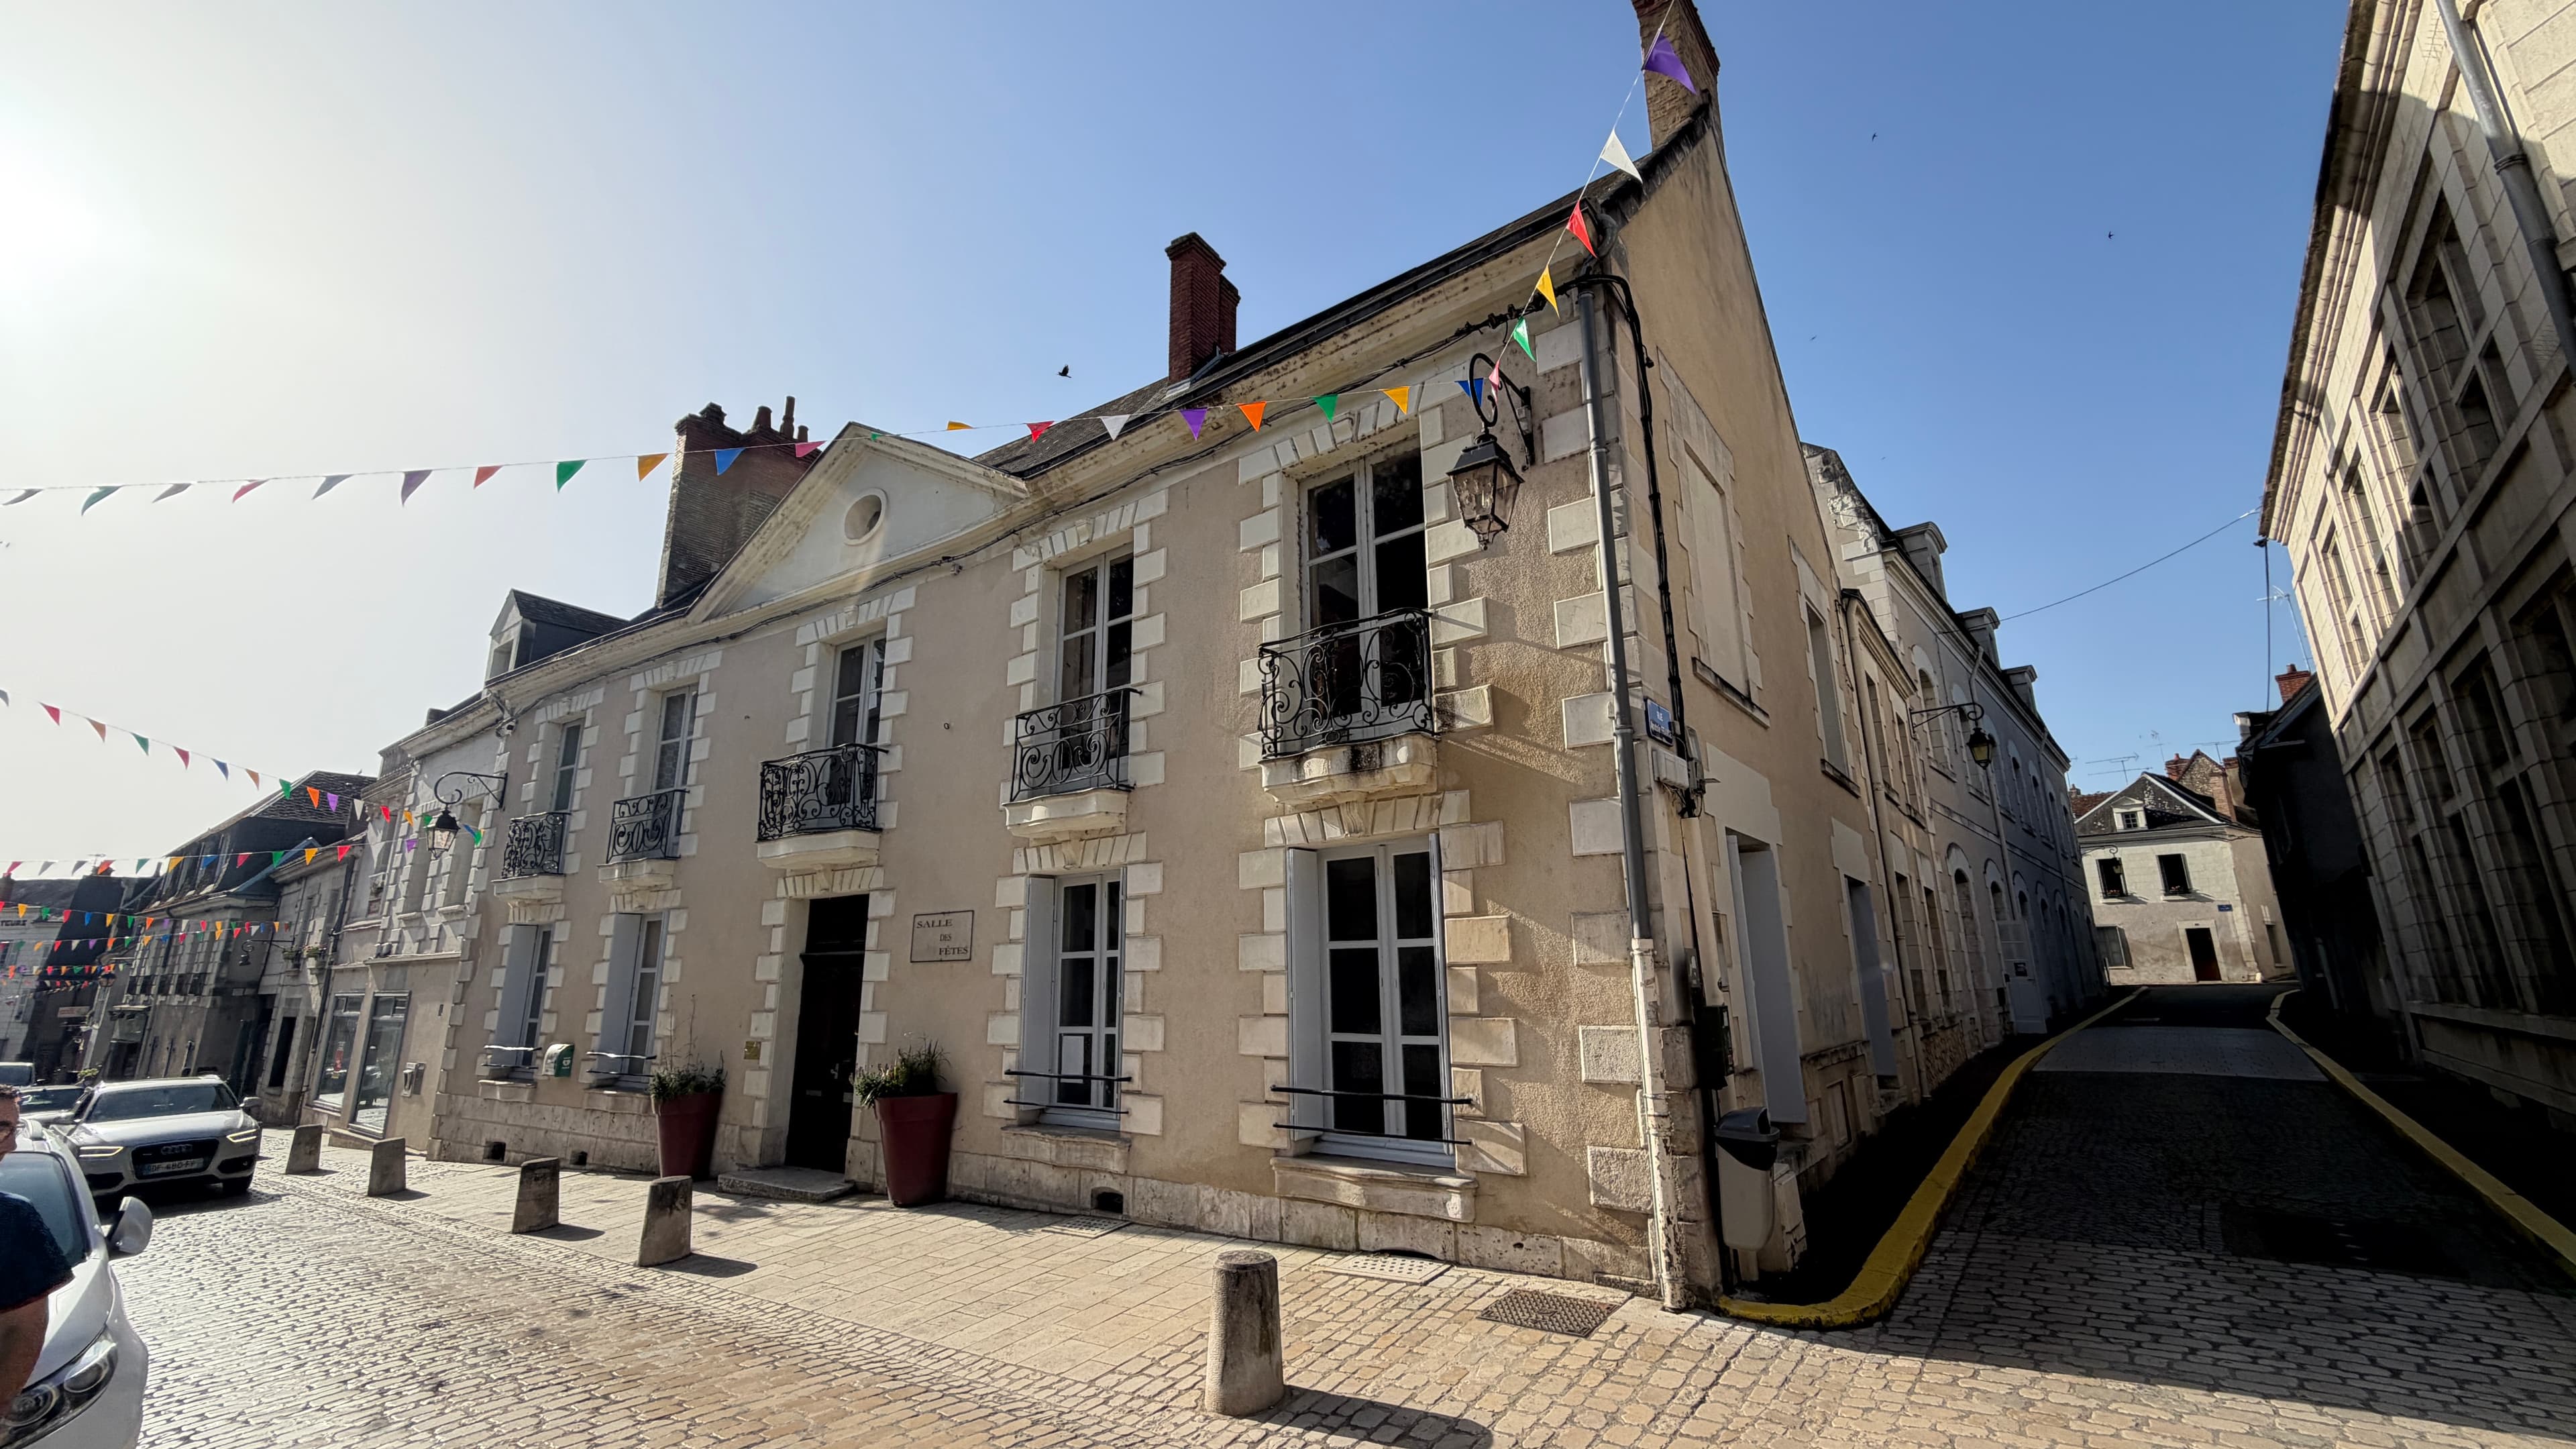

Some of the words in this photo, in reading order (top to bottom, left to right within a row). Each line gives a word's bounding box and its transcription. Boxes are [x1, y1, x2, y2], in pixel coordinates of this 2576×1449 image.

[916, 919, 953, 928] SALLE
[940, 933, 951, 941] DES
[939, 945, 968, 955] FÊTES
